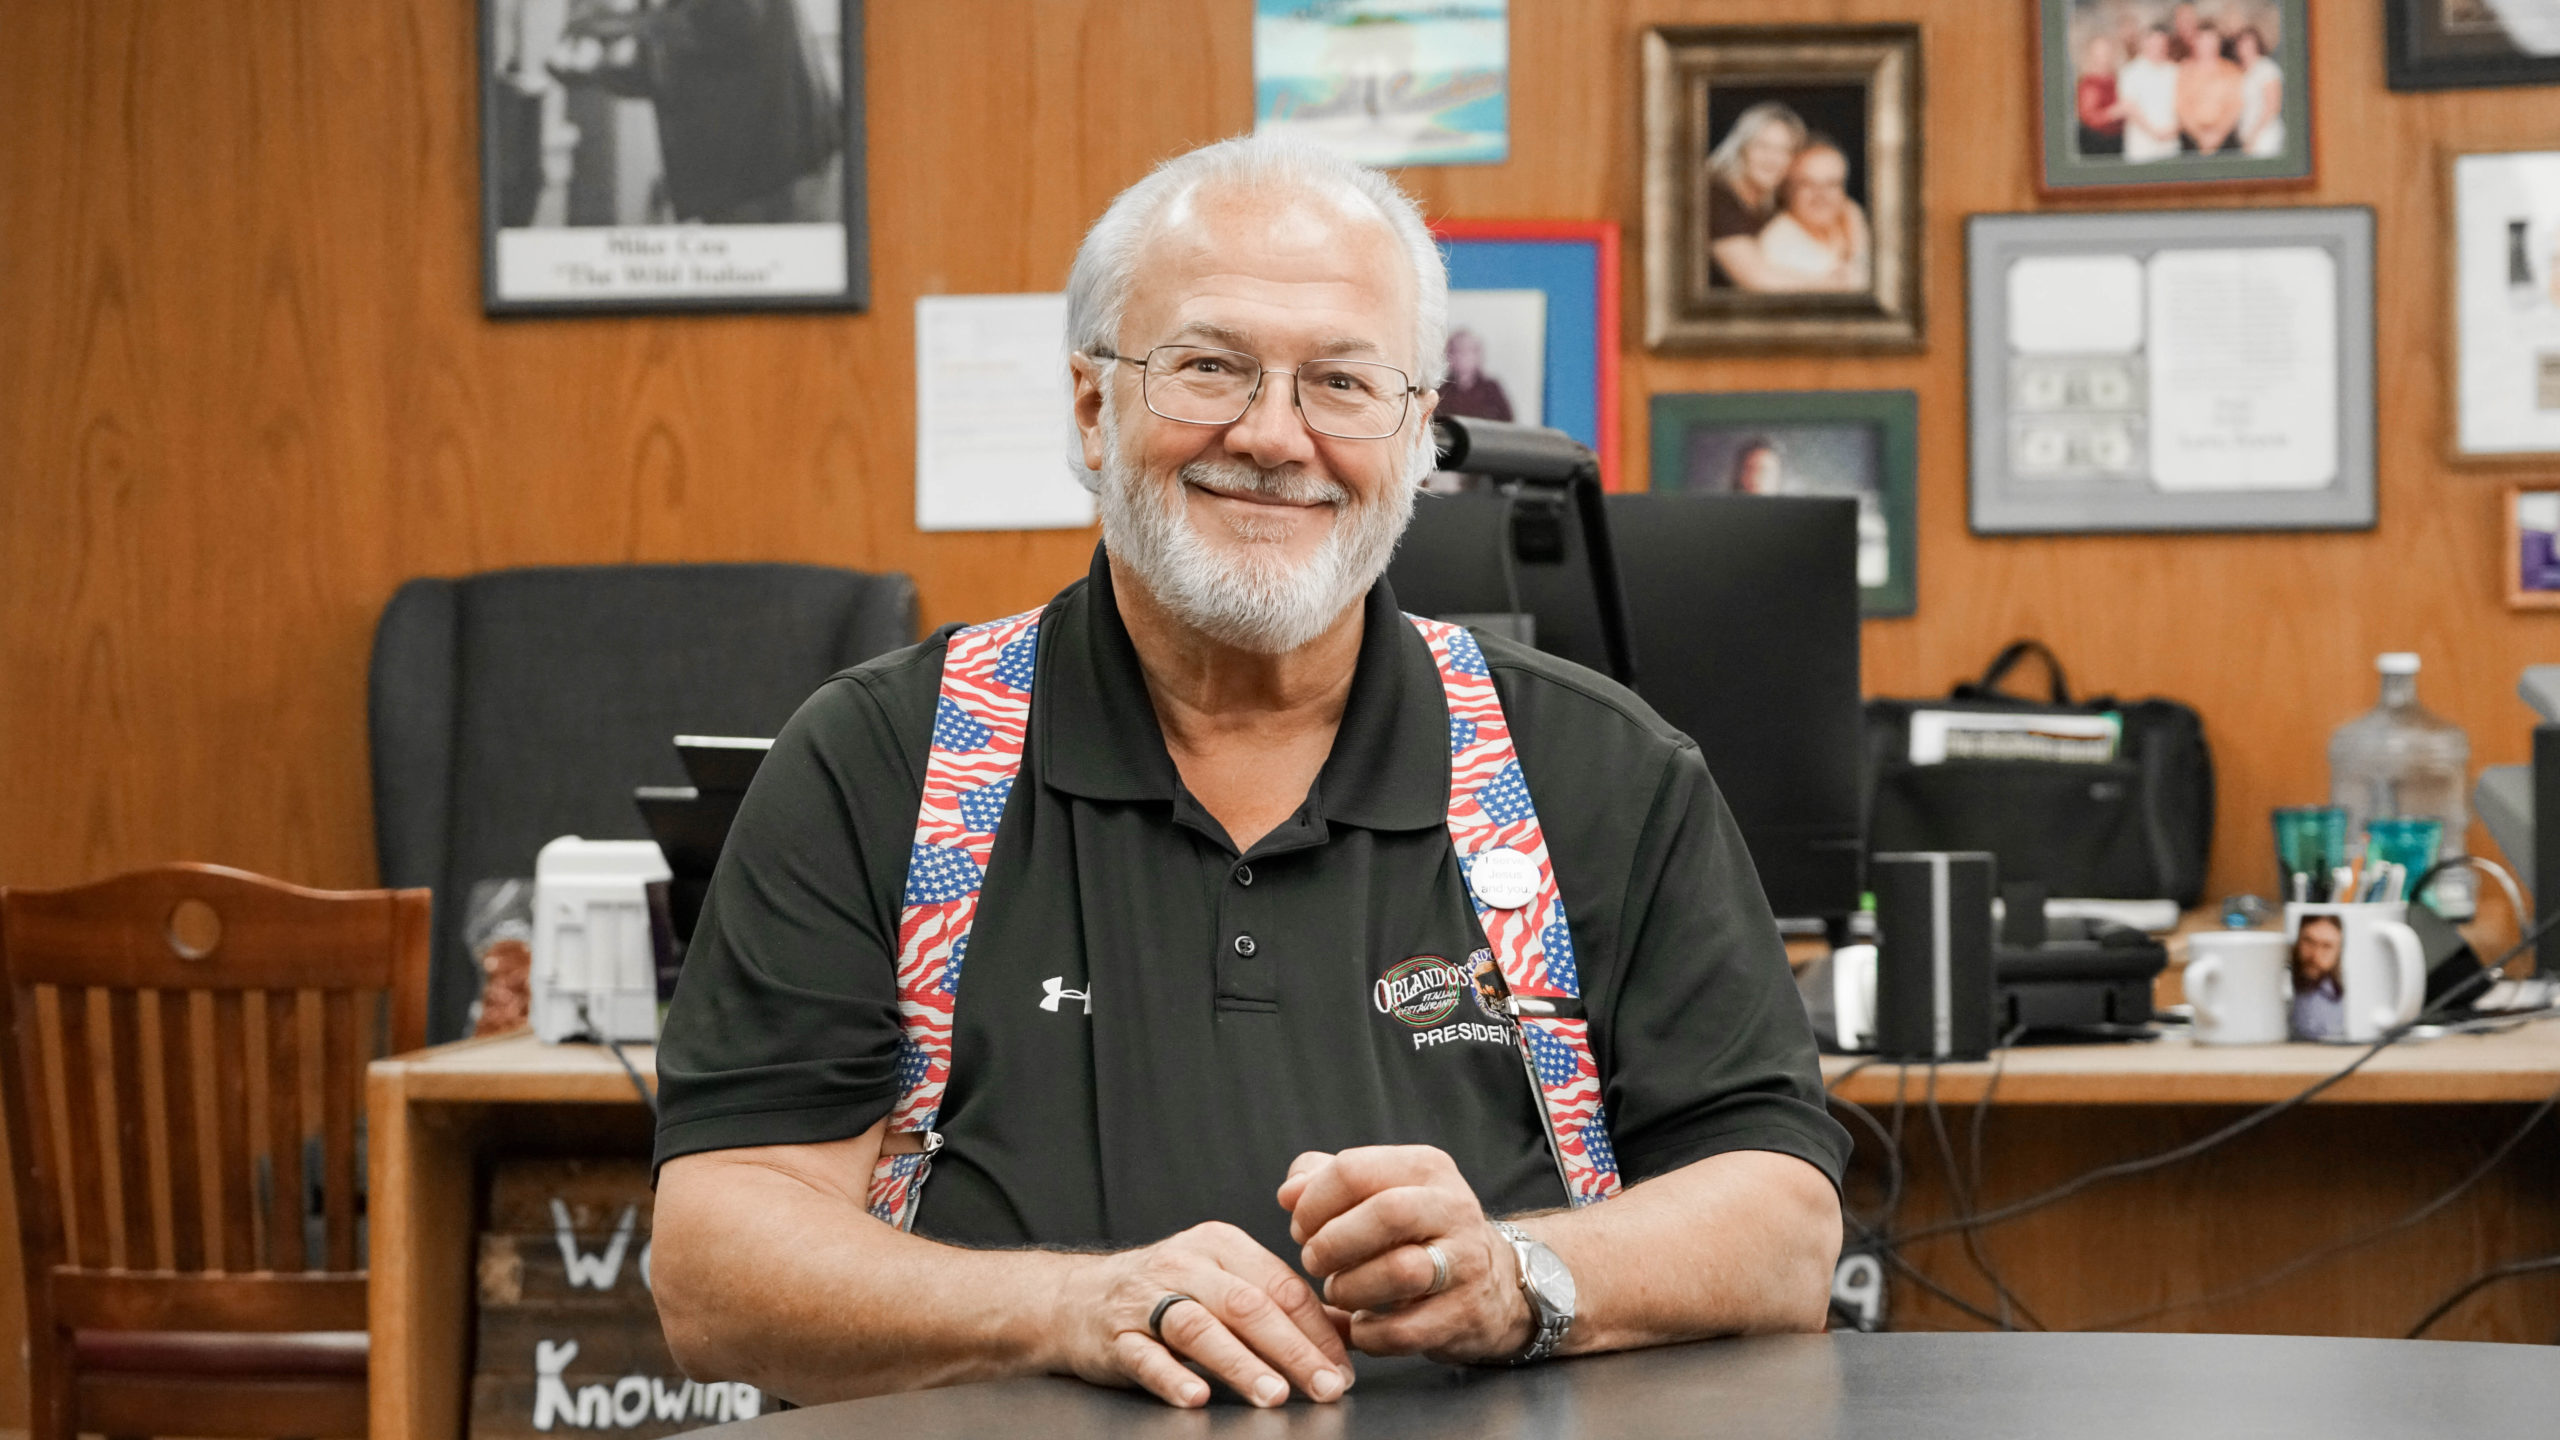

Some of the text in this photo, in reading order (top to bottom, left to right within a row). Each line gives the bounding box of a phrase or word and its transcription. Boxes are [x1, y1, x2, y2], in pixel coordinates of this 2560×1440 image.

[1488, 870, 1523, 880] Jesus
[1481, 884, 1504, 894] and
[1373, 962, 1471, 1014] ORLANDO'S
